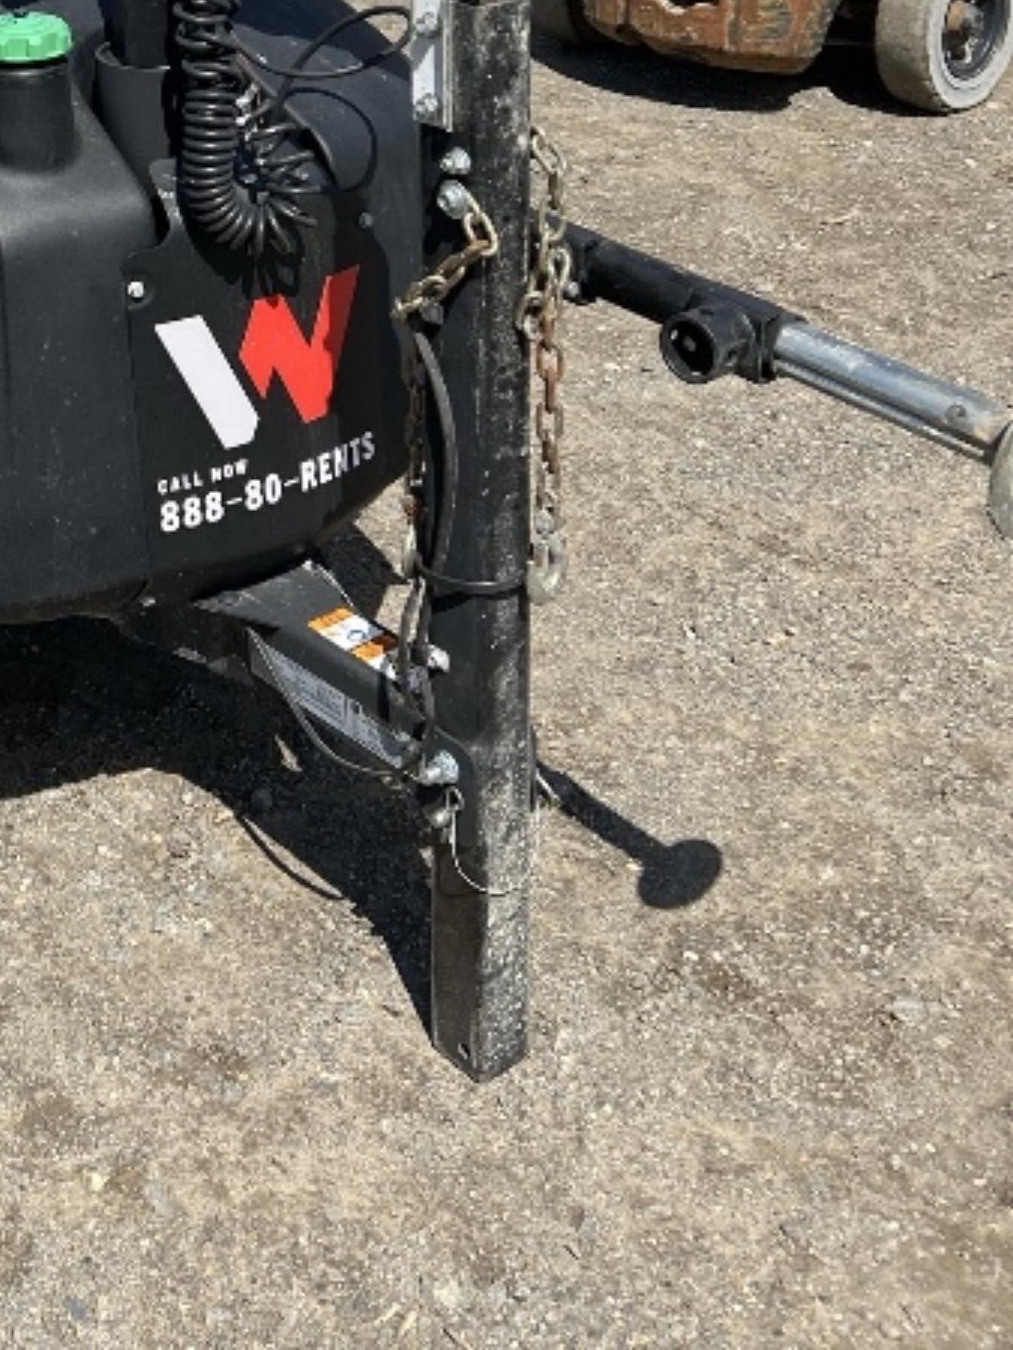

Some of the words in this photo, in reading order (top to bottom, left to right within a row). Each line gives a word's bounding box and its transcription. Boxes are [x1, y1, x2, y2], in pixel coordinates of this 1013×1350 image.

[157, 470, 204, 496] CALL
[211, 458, 249, 484] NOW
[159, 430, 376, 533] 888-80-RENTS
